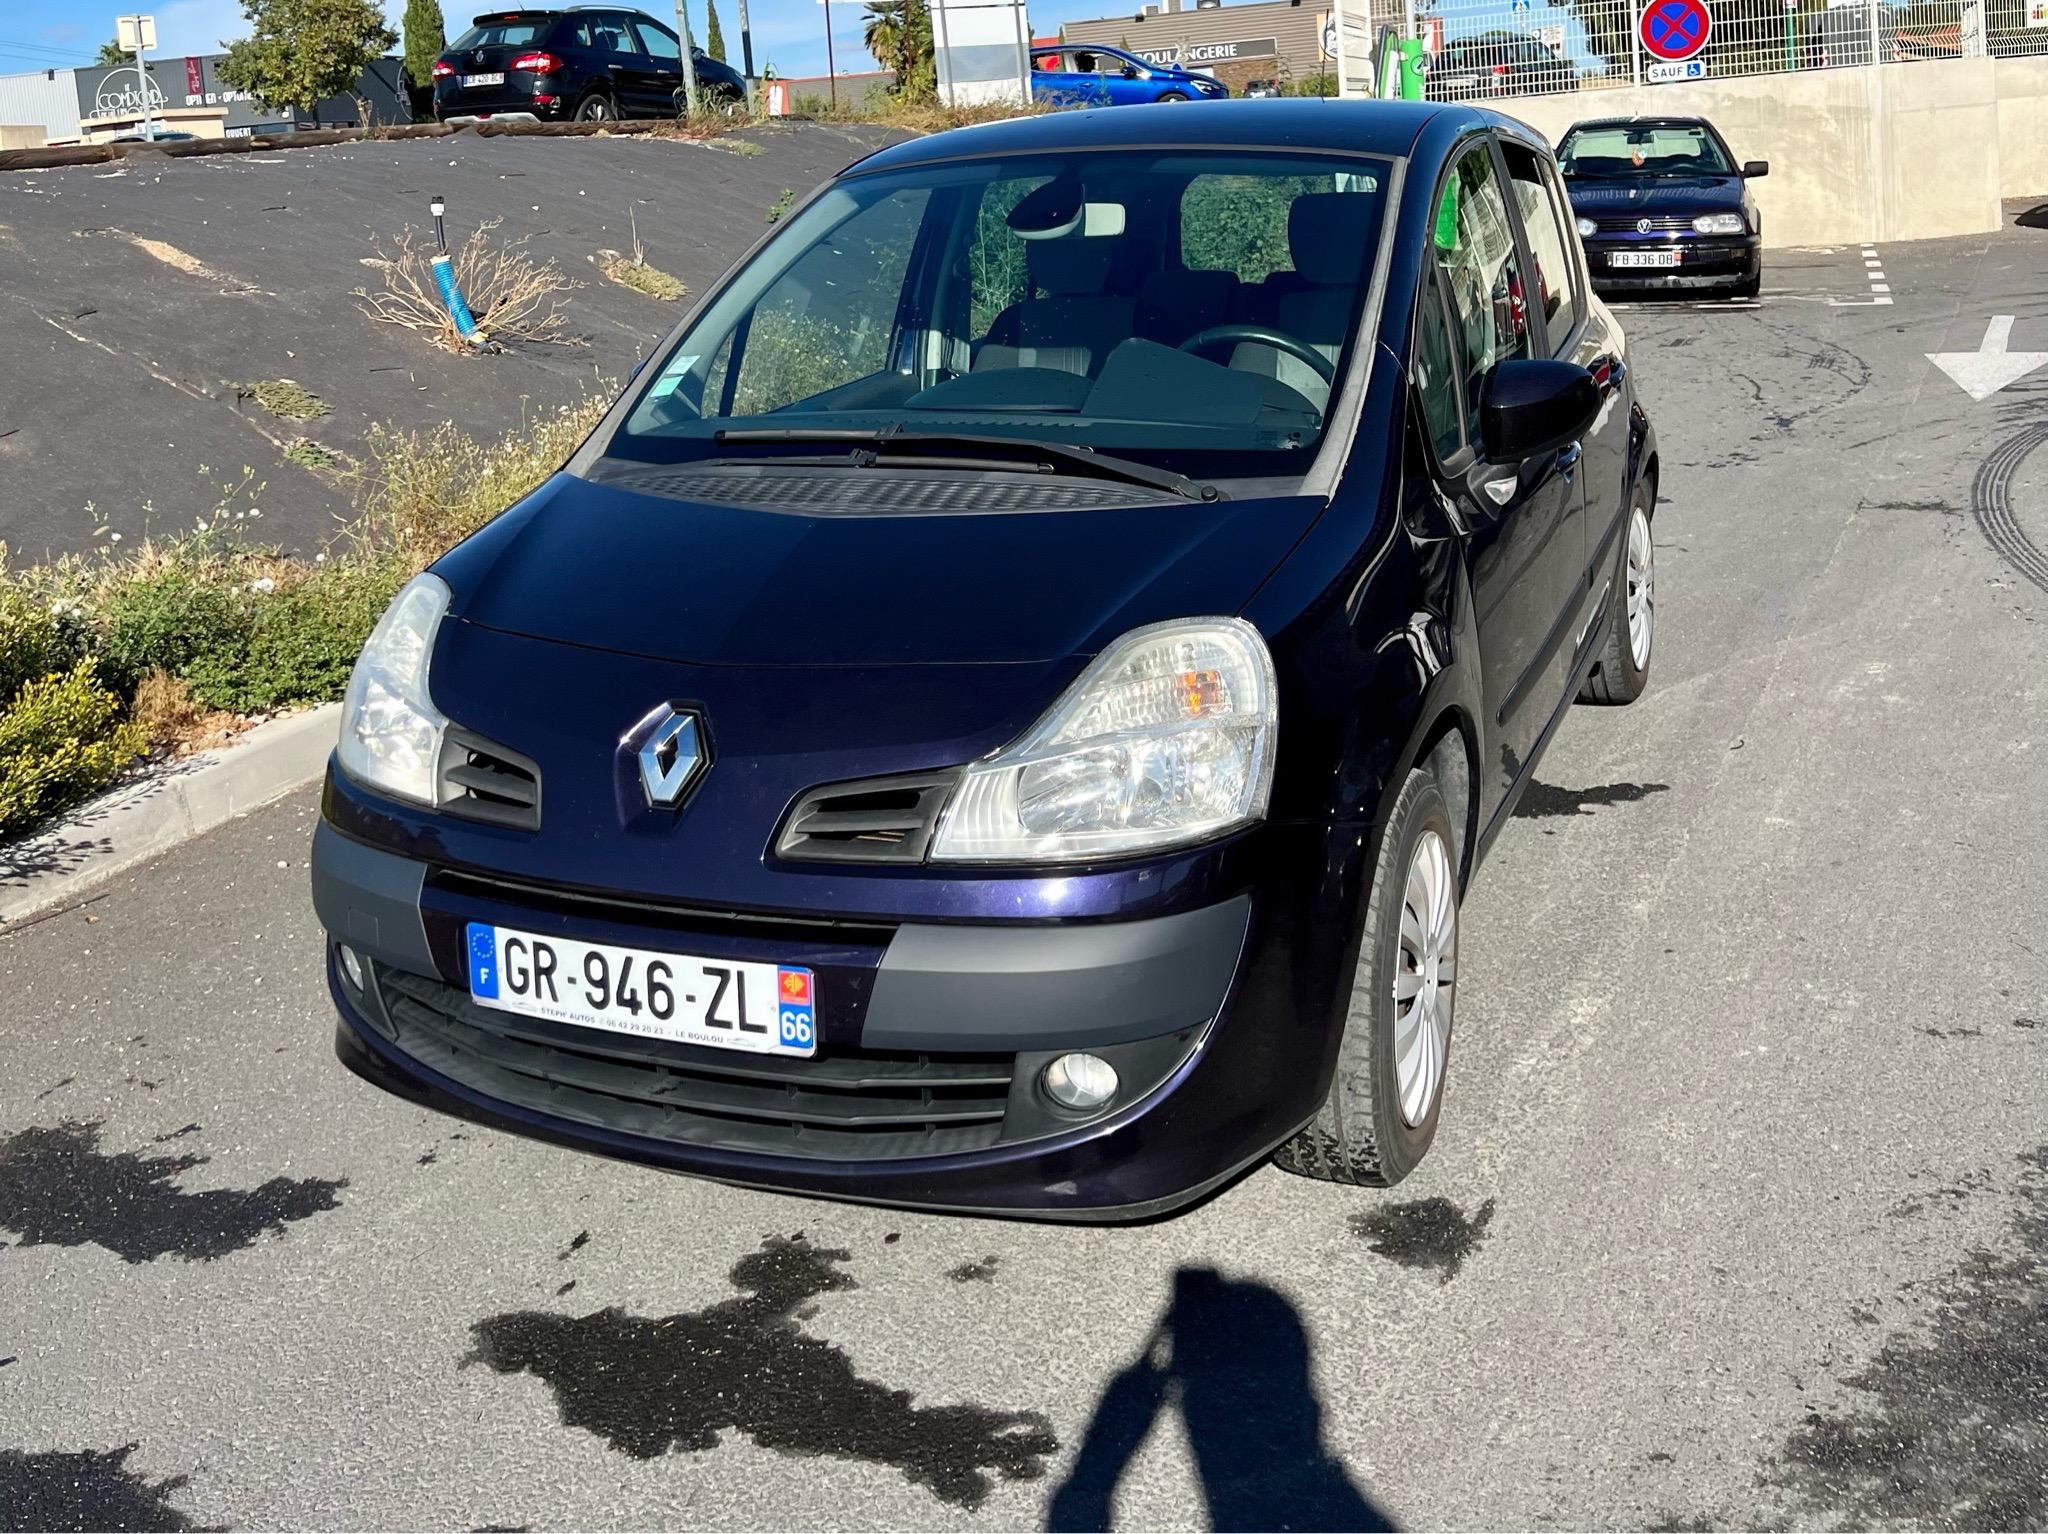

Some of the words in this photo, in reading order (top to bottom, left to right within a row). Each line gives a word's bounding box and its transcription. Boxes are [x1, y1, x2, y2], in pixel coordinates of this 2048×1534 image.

[1651, 67, 1684, 78] SAUF
[479, 967, 490, 985] F
[504, 937, 768, 1034] GR-946-ZL
[570, 1012, 596, 1024] AUTOS
[675, 1029, 686, 1039] LE
[688, 1031, 724, 1044] BOULOU
[781, 1011, 811, 1042] 66
